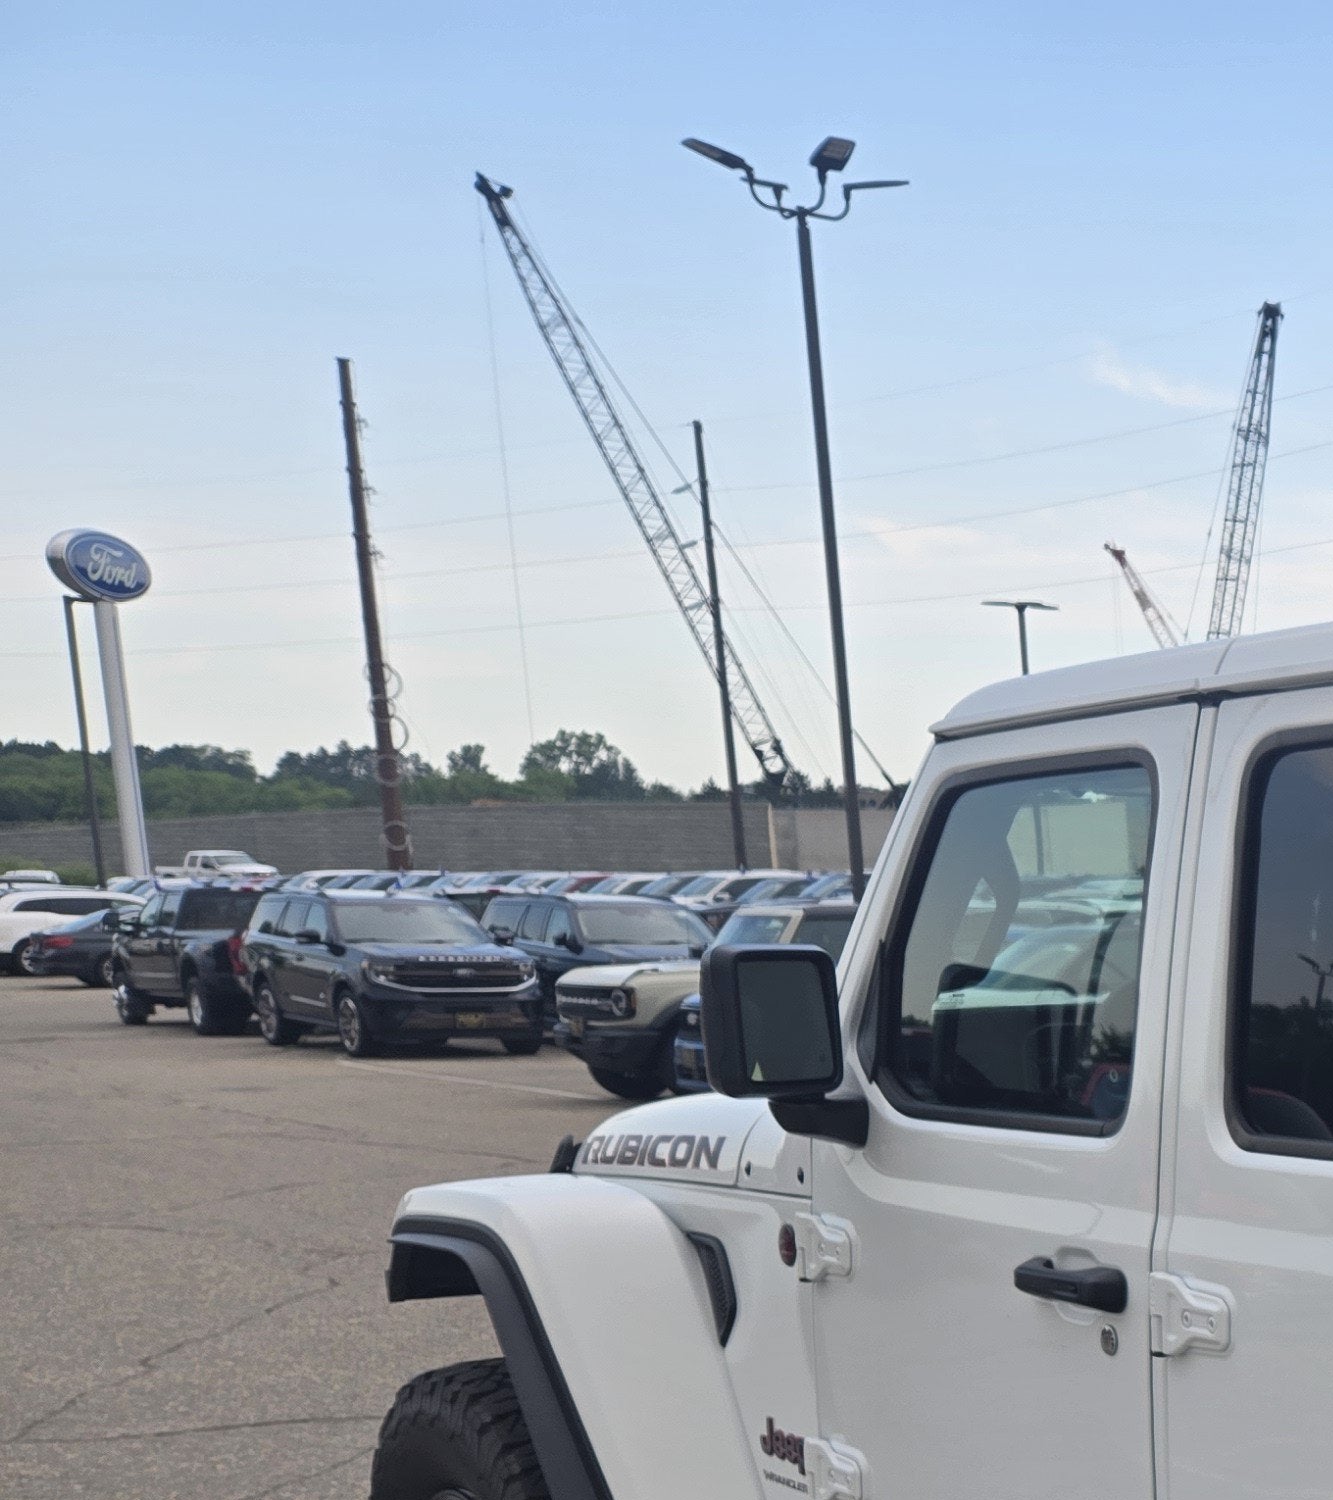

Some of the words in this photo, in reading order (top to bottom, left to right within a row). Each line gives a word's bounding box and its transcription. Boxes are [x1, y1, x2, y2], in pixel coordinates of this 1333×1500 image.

[87, 543, 138, 588] Ford
[581, 1134, 726, 1169] RUBICON
[760, 1416, 806, 1475] Jeep
